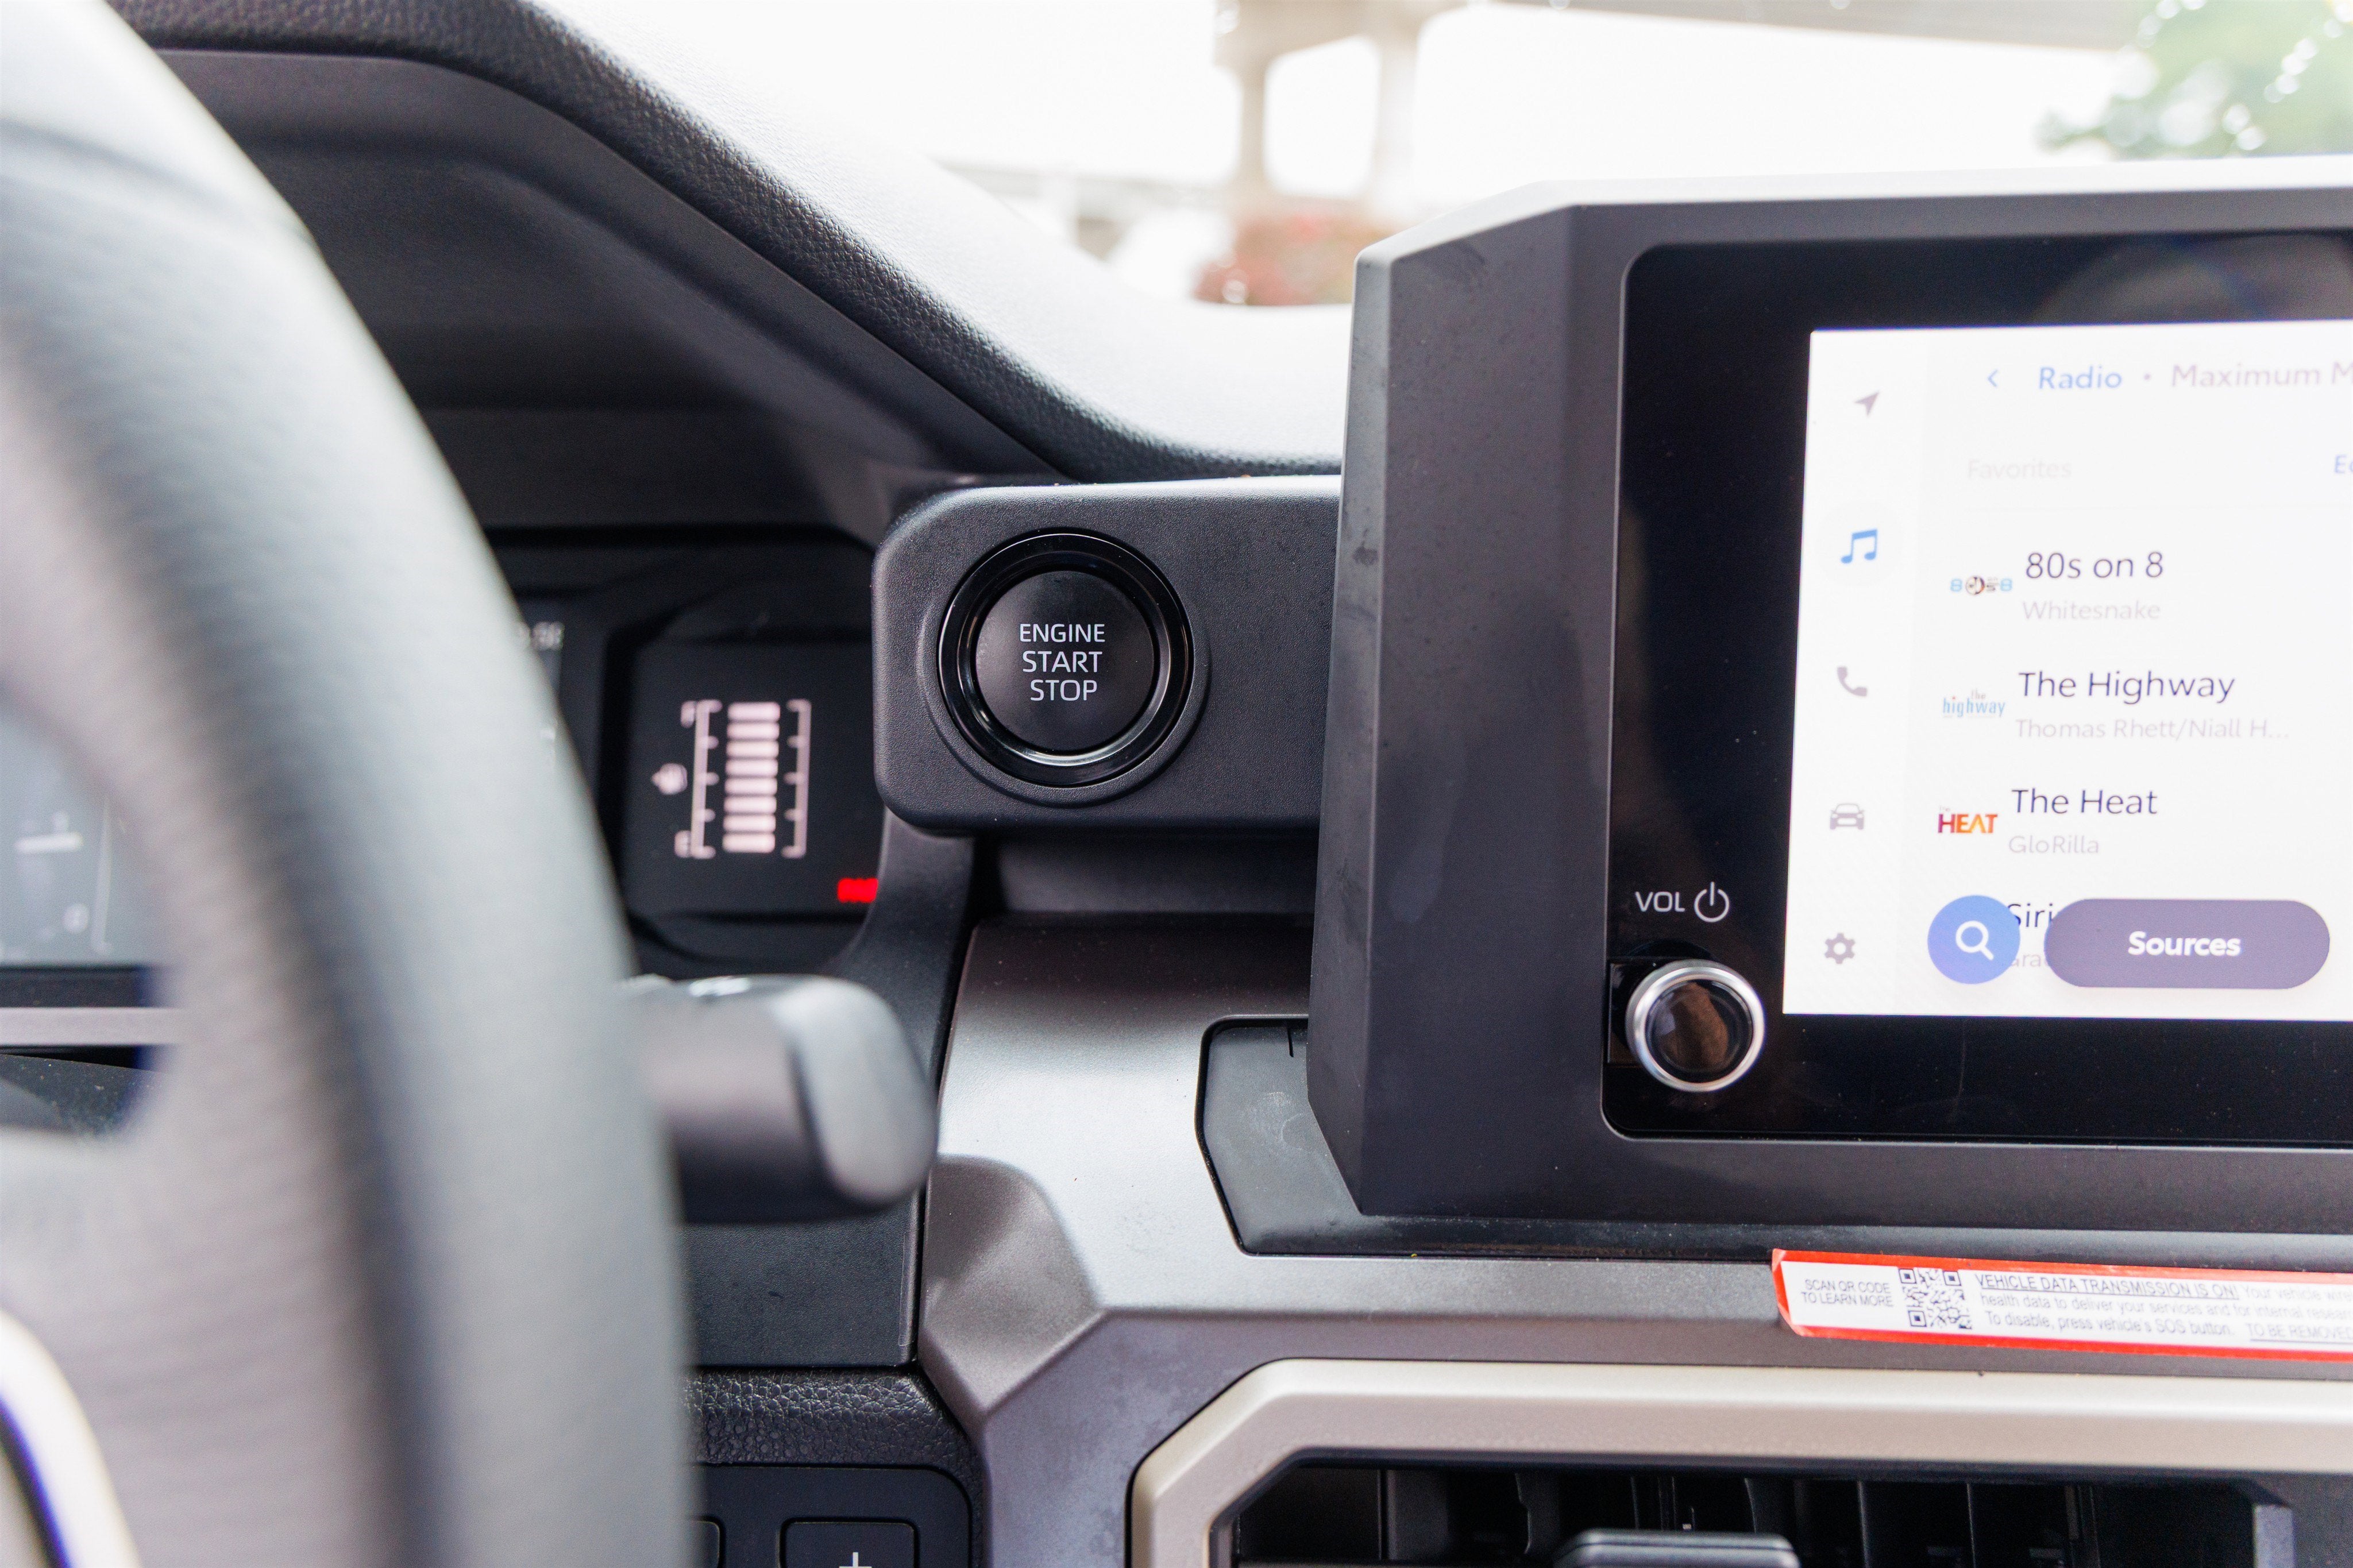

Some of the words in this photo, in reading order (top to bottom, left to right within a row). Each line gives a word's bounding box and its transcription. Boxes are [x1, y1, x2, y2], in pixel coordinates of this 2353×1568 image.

[2039, 364, 2123, 389] Radio
[2171, 361, 2321, 388] Maximum
[1968, 457, 2073, 480] Favorites
[2333, 453, 2353, 474] E
[2026, 551, 2082, 580] 80s
[2093, 558, 2134, 579] on
[2145, 550, 2164, 578] 8
[2022, 600, 2161, 620] Whitesnake
[1020, 623, 1105, 643] ENGINE
[1023, 650, 1103, 673] START
[1030, 679, 1097, 701] STOP
[2018, 670, 2077, 697] The
[2088, 670, 2235, 705] Highway
[1942, 696, 2006, 718] highway
[2015, 719, 2107, 739] Thomas
[2113, 718, 2242, 741] Rhett/Niall
[2011, 787, 2069, 814] The
[2080, 789, 2158, 815] Heat
[1938, 813, 1999, 834] HEAT
[2008, 835, 2100, 855] GloRilla
[1634, 891, 1685, 913] VOL
[2127, 930, 2242, 957] Sources
[1804, 1279, 1837, 1291] SCAN
[1858, 1281, 1891, 1293] CODE
[1974, 1273, 2038, 1289] VEHICLE
[2040, 1276, 2080, 1292] DATA
[2080, 1278, 2192, 1296] TRANSMISSION
[2194, 1283, 2209, 1296] IS
[2240, 1284, 2271, 1299] Your
[2277, 1286, 2322, 1301] vehicle
[1800, 1291, 1817, 1304] TO
[1819, 1292, 1857, 1306] LEARN
[1859, 1294, 1894, 1307] MORE
[1980, 1292, 2020, 1307] health
[2023, 1293, 2051, 1308] data
[2054, 1296, 2067, 1309] to
[2072, 1296, 2113, 1311] deliver
[2117, 1300, 2144, 1315] your
[2149, 1301, 2202, 1315] services
[2206, 1303, 2231, 1316] and
[1985, 1310, 2001, 1325] To
[2058, 1316, 2093, 1332] press
[2155, 1318, 2186, 1334] SOS
[2245, 1322, 2265, 1337] TO
[2267, 1323, 2286, 1338] BE
